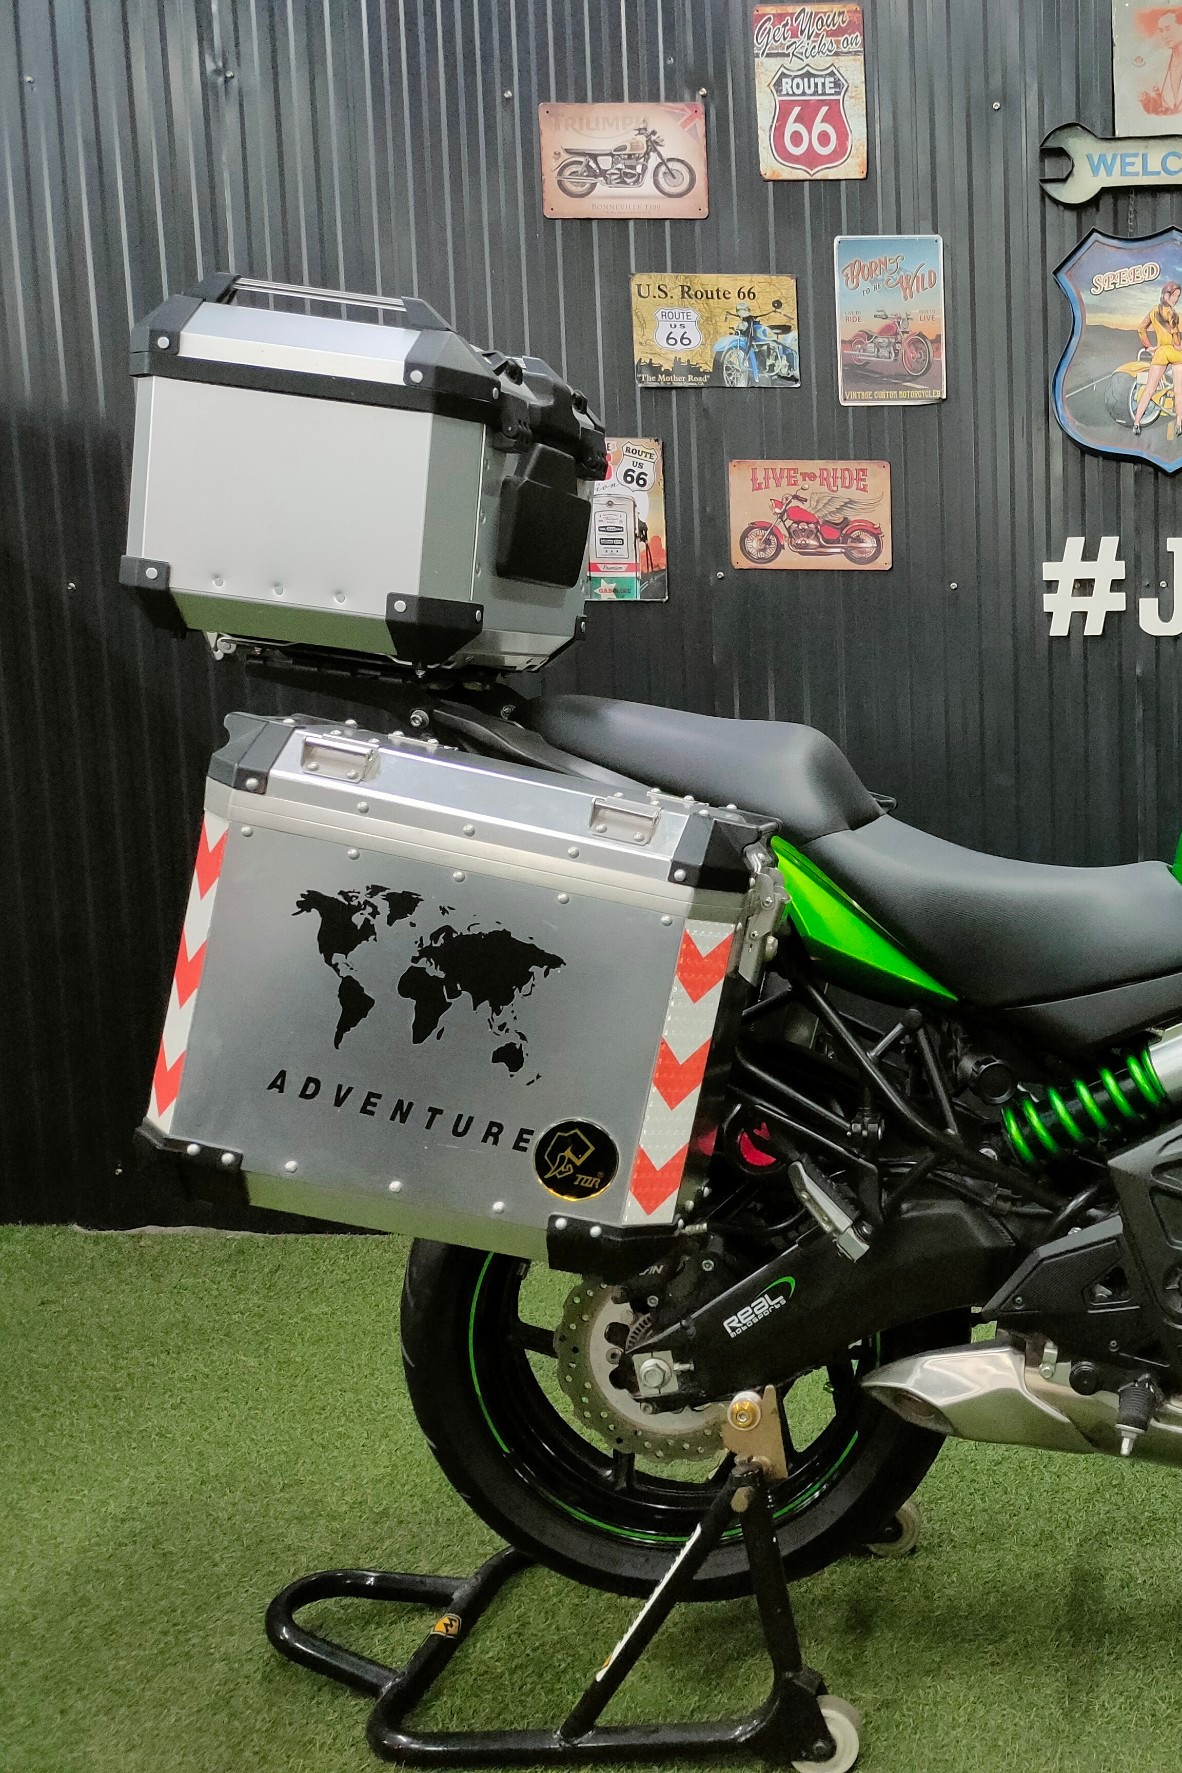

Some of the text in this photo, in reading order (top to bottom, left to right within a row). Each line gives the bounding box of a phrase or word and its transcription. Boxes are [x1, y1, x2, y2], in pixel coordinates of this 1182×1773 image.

[755, 7, 848, 58] Get Your
[785, 33, 861, 64] Kicks on
[781, 77, 835, 95] ROUTE
[784, 106, 837, 155] 66
[842, 255, 896, 290] BORN
[885, 263, 937, 301] WILD
[1090, 261, 1160, 295] SPEED
[635, 284, 757, 301] U.S. Route 66
[661, 311, 692, 321] ROUTE
[665, 331, 692, 347] 66
[658, 374, 686, 382] Mother
[625, 446, 655, 460] ROUTE
[632, 461, 644, 469] US
[623, 468, 649, 488] 66
[750, 467, 869, 493] LIVE TO RIDE
[266, 1069, 535, 1153] ADVENTURE
